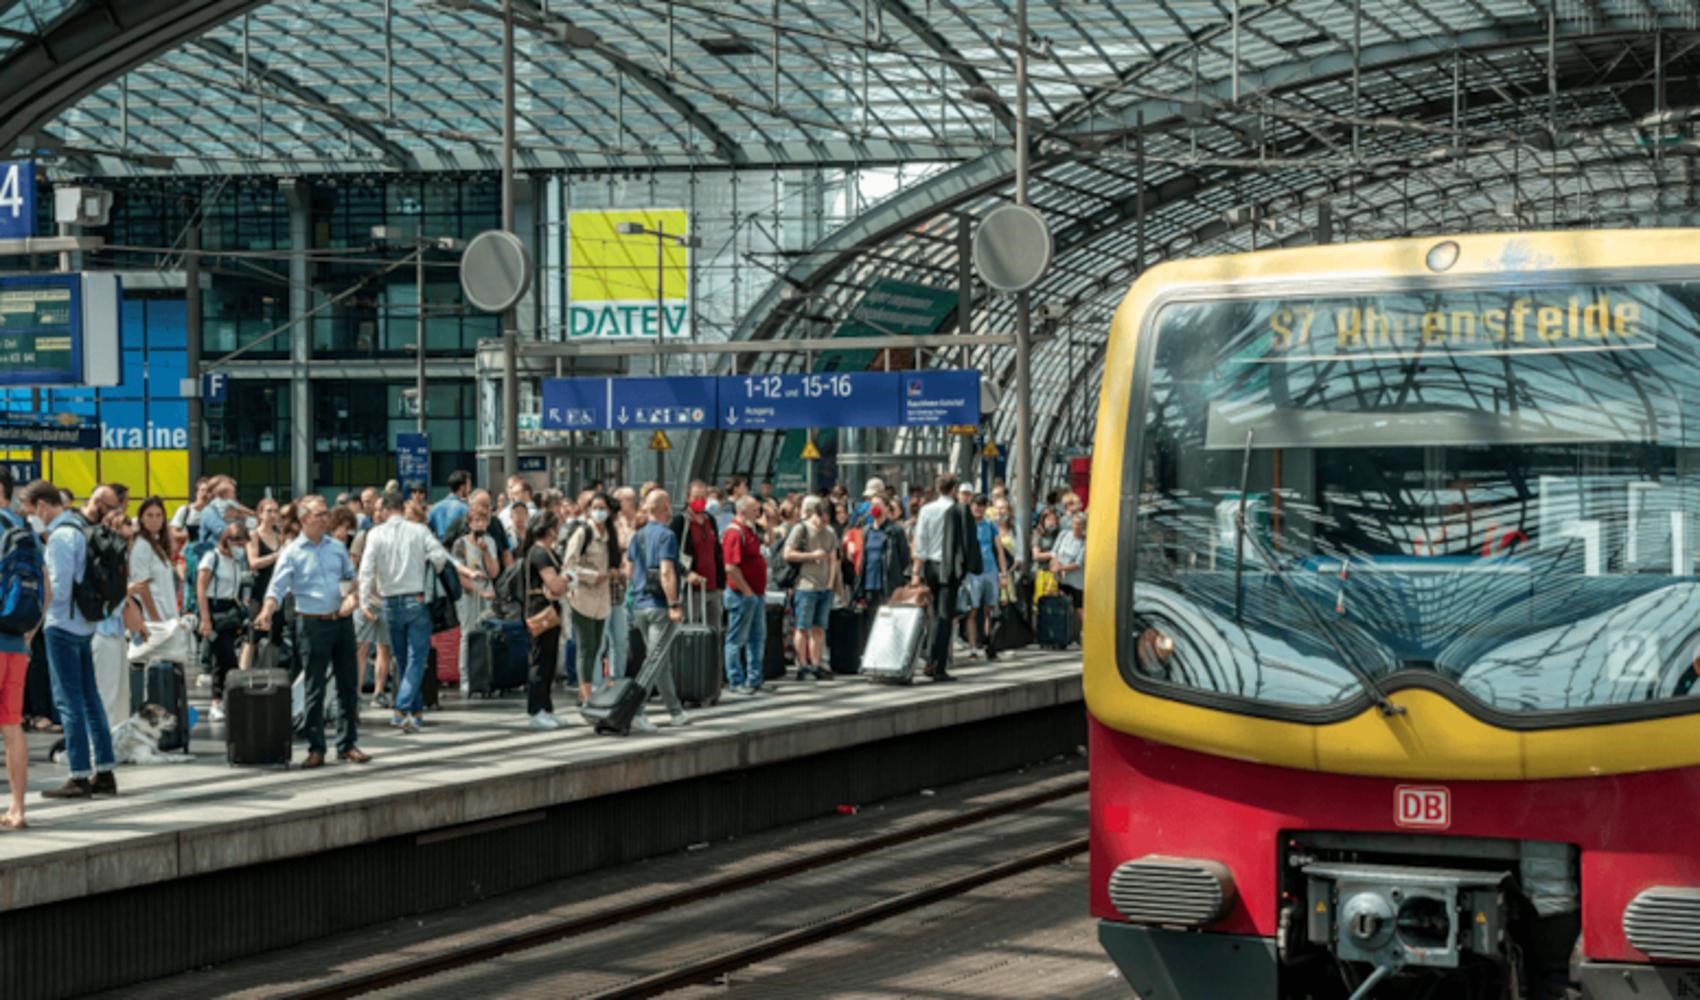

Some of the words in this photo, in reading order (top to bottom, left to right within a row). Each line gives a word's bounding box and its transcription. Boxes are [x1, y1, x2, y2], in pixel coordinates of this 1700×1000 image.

[0, 164, 23, 217] 4
[570, 305, 687, 336] DATEV
[1270, 305, 1314, 349] S7
[211, 373, 223, 397] F
[744, 376, 782, 398] 1-12
[802, 374, 852, 397] 15-16
[80, 421, 187, 448] kraine
[1403, 793, 1442, 819] DB
